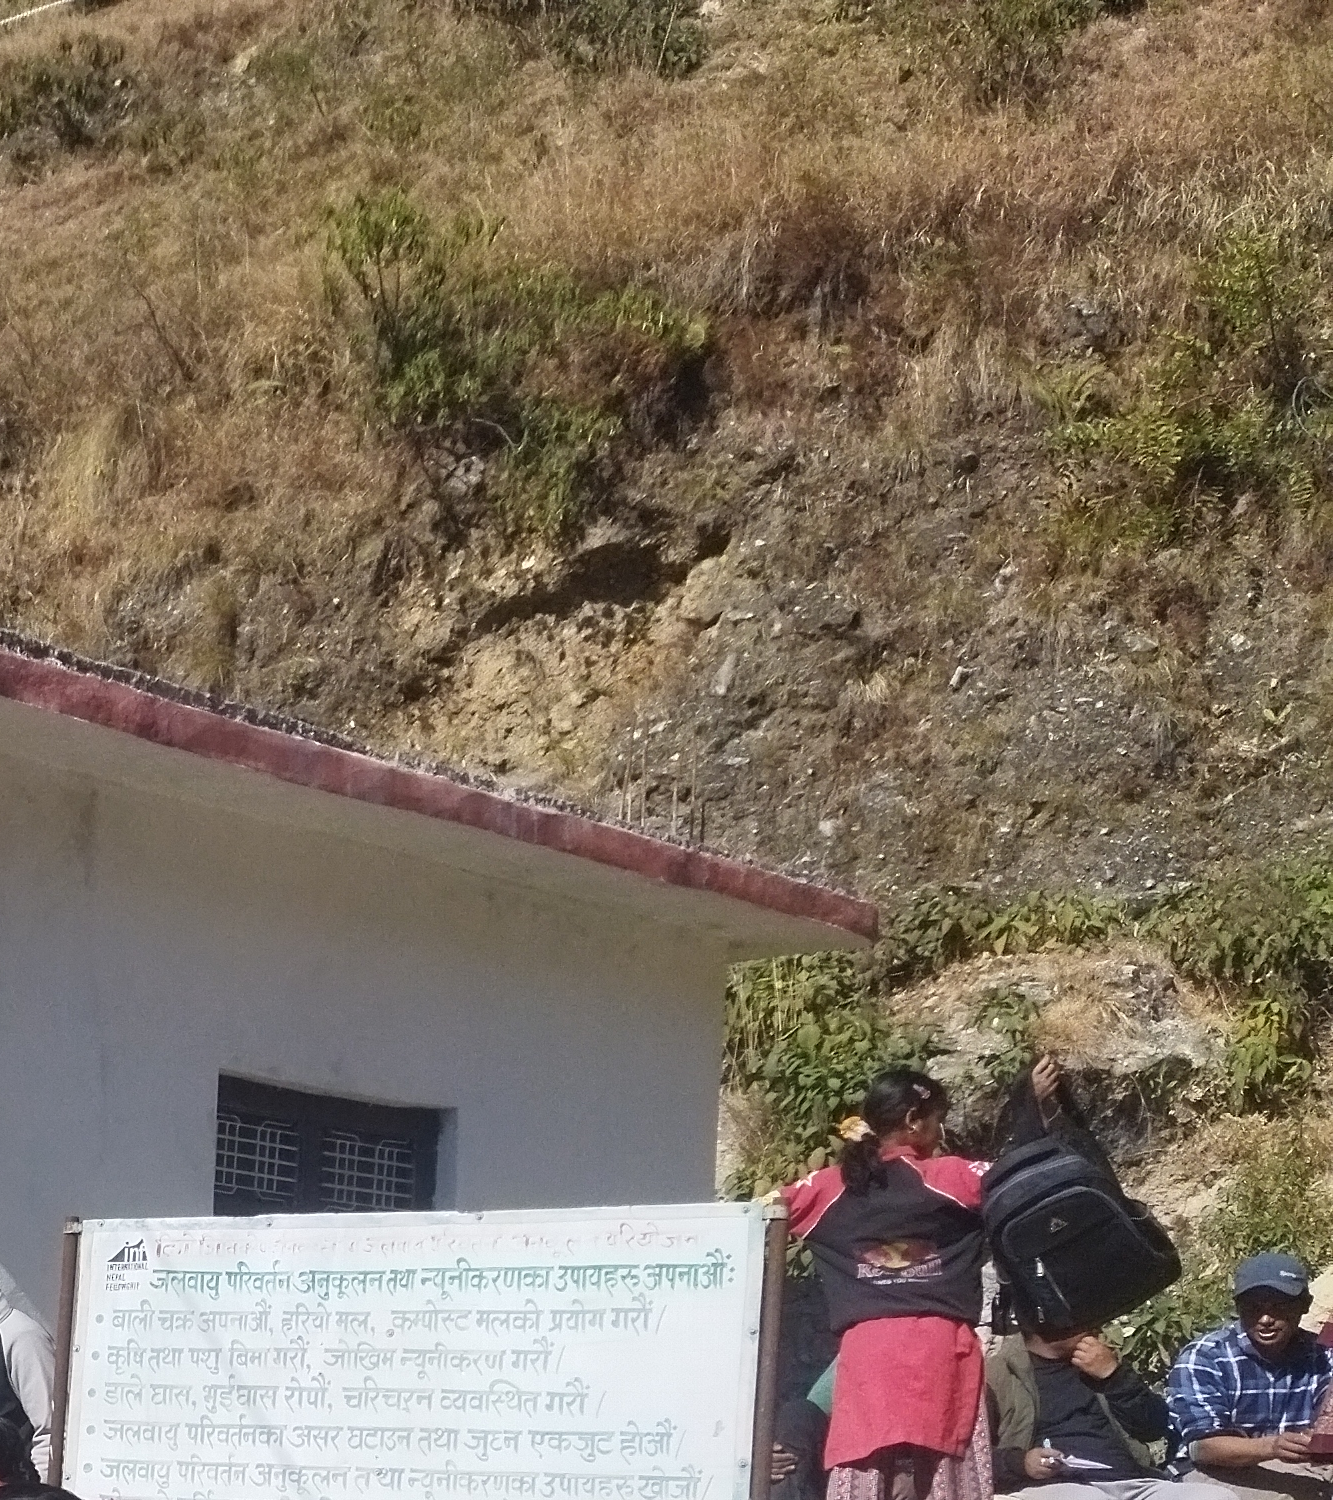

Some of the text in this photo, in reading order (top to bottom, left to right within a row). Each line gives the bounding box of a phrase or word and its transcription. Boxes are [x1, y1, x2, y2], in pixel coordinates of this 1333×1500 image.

[150, 1268, 222, 1300] जलवायु
[225, 1260, 290, 1298] परिवर्तन
[292, 1269, 386, 1301] अनुकूलन
[386, 1268, 417, 1297] तथा
[421, 1257, 554, 1301] न्यूनीकरणका
[112, 1299, 155, 1335] बाली
[158, 1309, 195, 1333] चक्र
[281, 1302, 332, 1337] हरियो
[391, 1299, 472, 1334] कम्पोस्ट
[476, 1299, 543, 1336] मलको
[548, 1299, 606, 1334] प्रयोग
[107, 1338, 147, 1375] कृषि
[148, 1348, 184, 1373] तथा
[189, 1348, 222, 1374] पशु
[229, 1339, 271, 1371] बिमा
[322, 1339, 397, 1371] जोखिम
[402, 1341, 506, 1380] न्यूनीकरण
[104, 1373, 143, 1411] डाले
[440, 1379, 542, 1418] व्यवस्थित
[103, 1419, 180, 1452] जलवायु
[185, 1413, 287, 1448] परिवर्तनका
[288, 1425, 344, 1452] असर
[347, 1425, 415, 1452] घटाउन
[417, 1427, 460, 1457] तथा
[99, 1458, 171, 1489] जलवायु
[176, 1453, 249, 1486] परिवर्तन
[249, 1463, 351, 1495] अनुकूलन
[408, 1459, 540, 1500] न्यूनीकरणका
